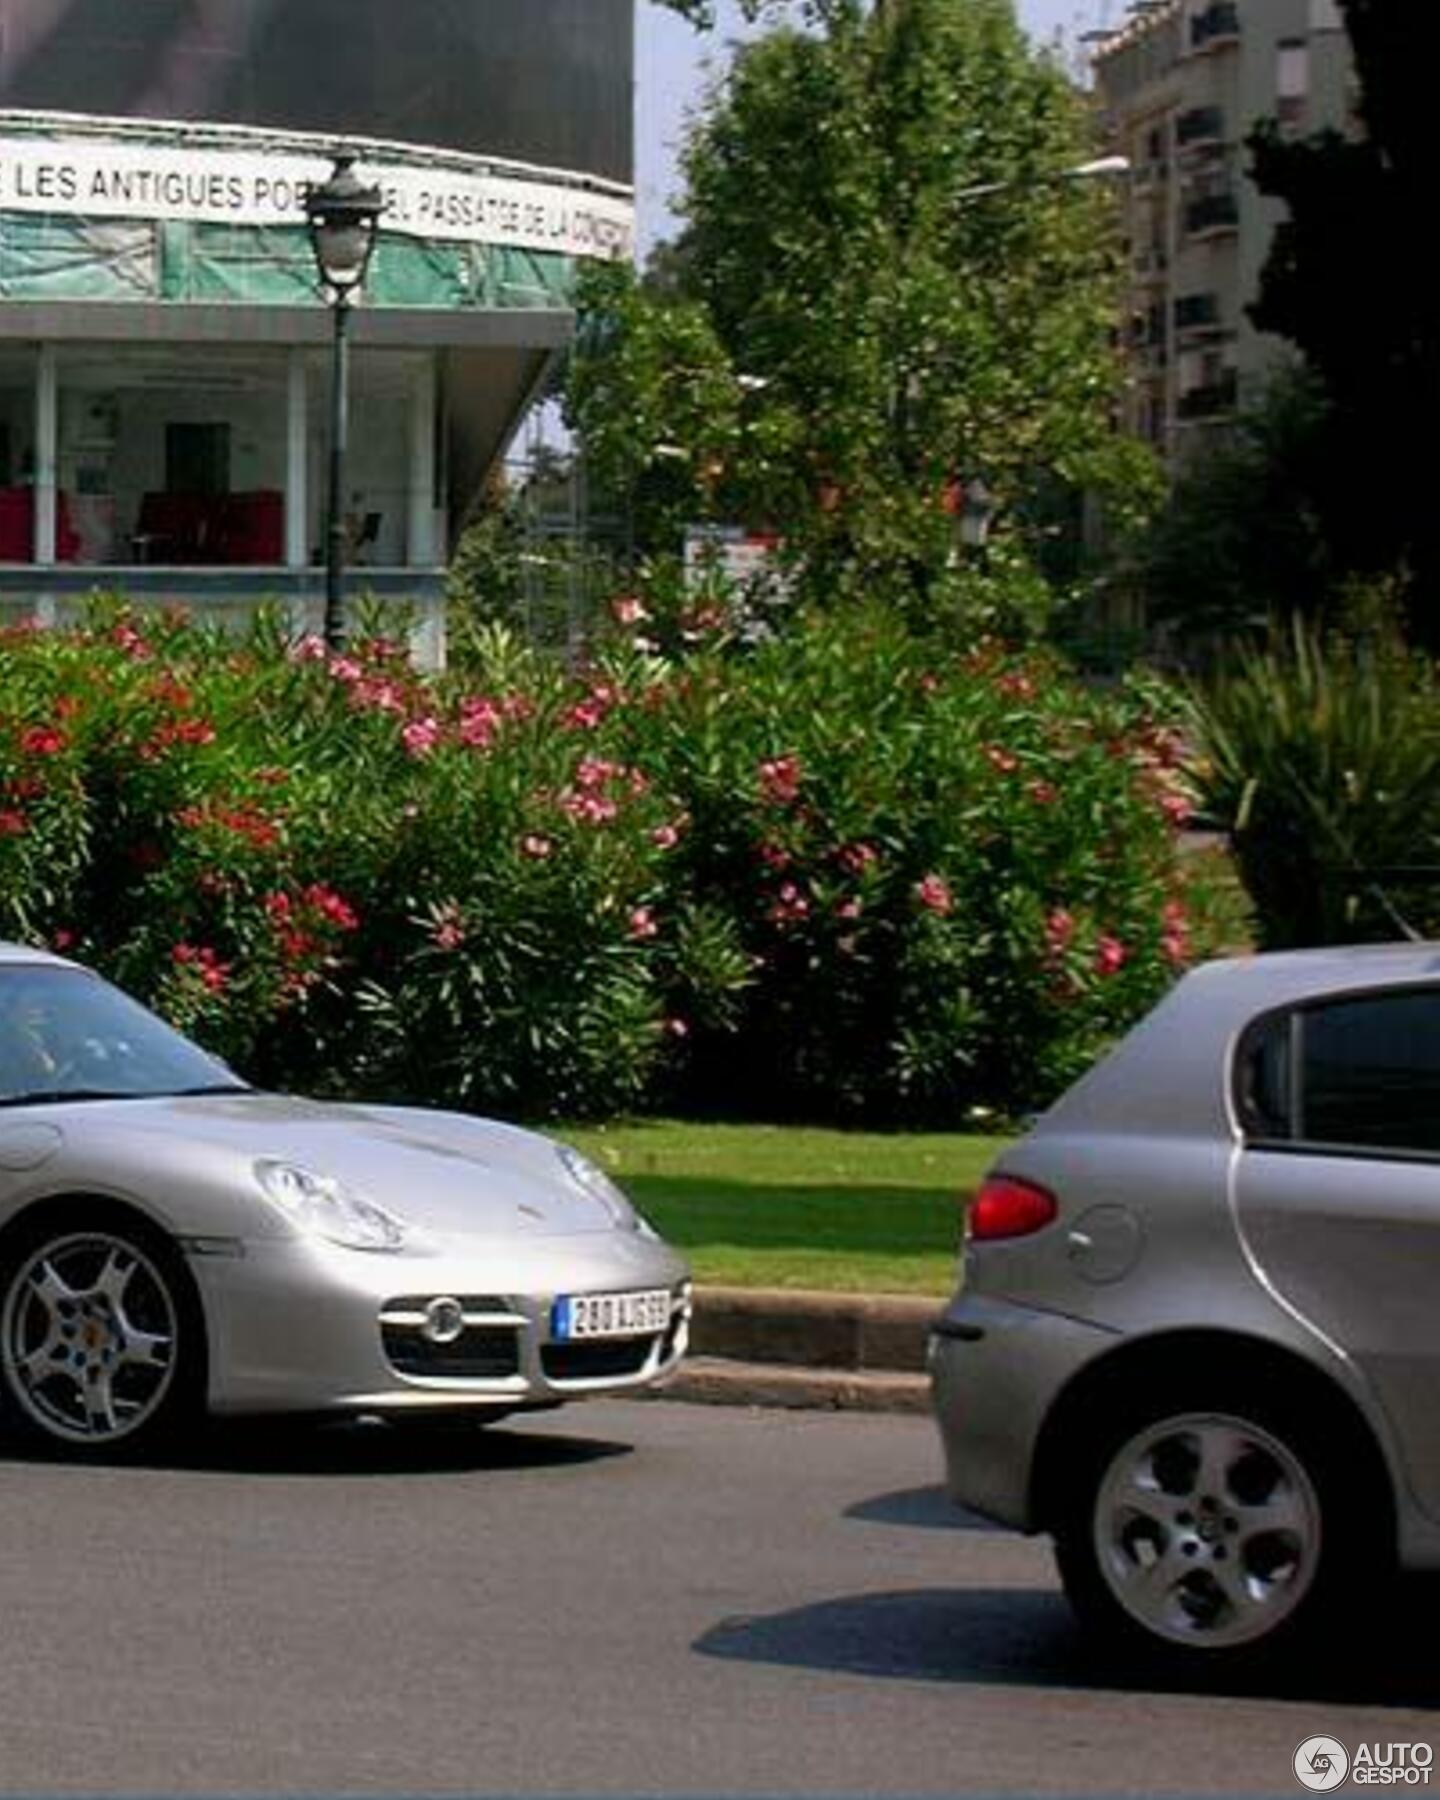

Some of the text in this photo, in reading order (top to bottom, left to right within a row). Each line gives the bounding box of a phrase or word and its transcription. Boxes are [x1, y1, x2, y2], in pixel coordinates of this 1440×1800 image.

[16, 164, 78, 200] LES
[90, 169, 250, 210] ANTIGUES
[420, 191, 518, 232] PASSATGE
[574, 1299, 613, 1334] 280
